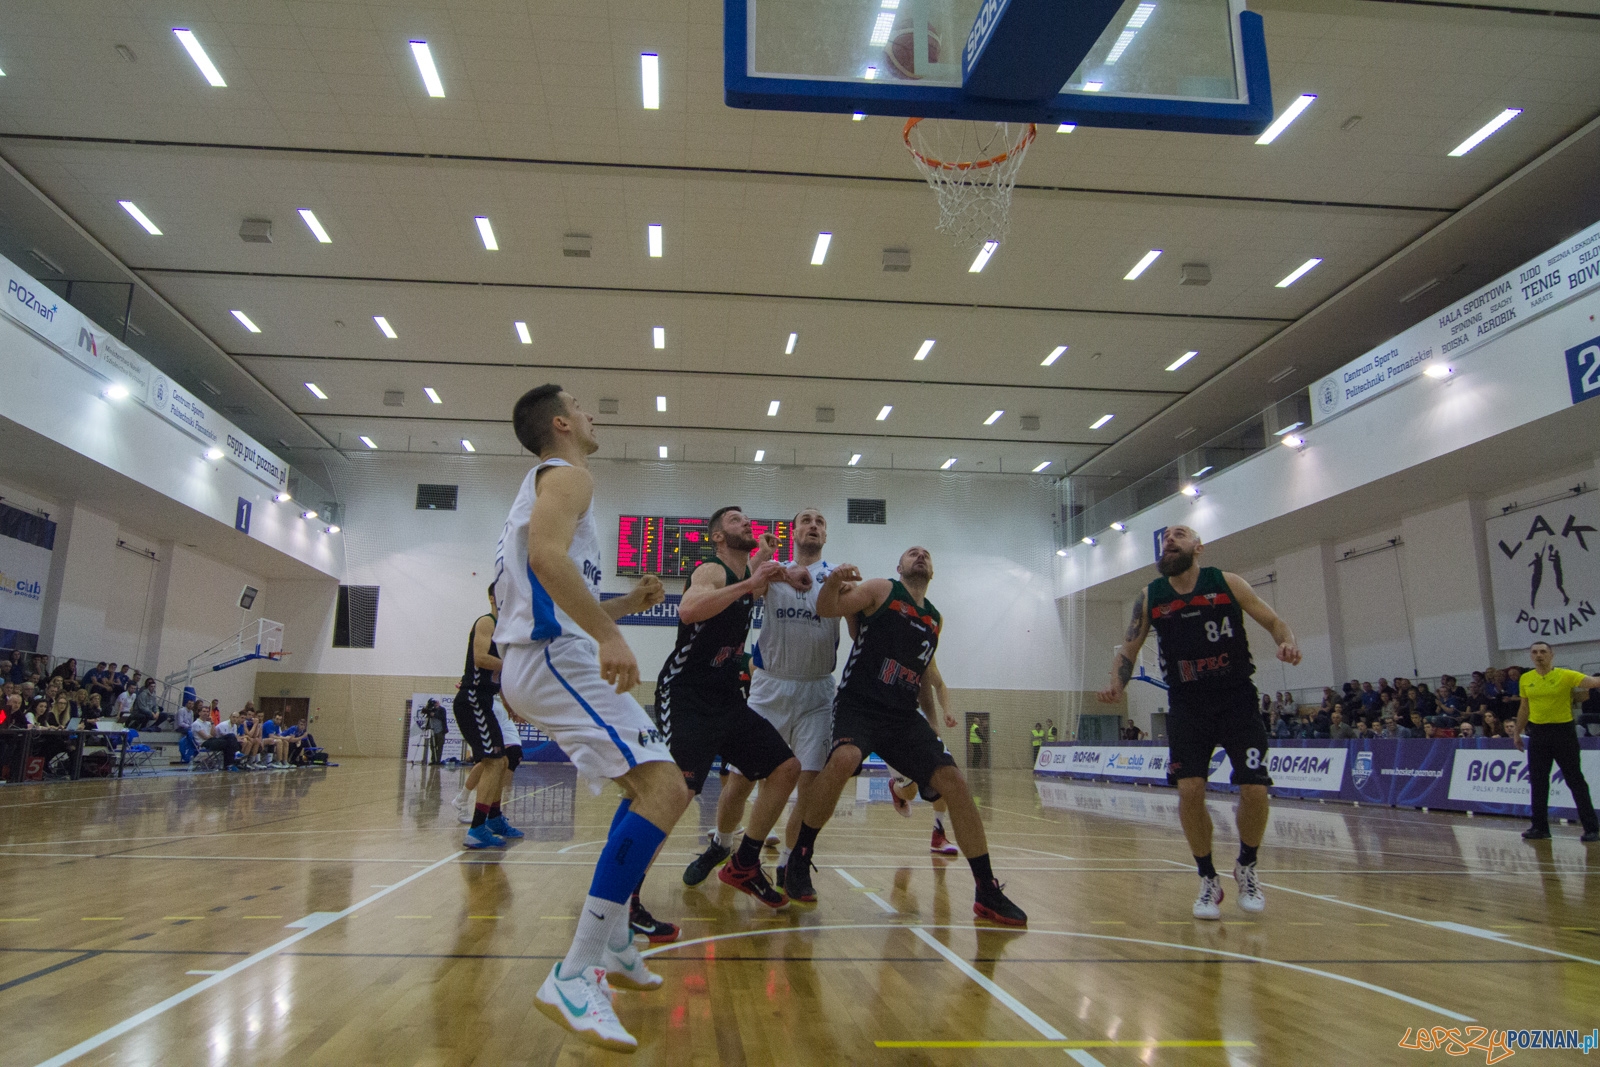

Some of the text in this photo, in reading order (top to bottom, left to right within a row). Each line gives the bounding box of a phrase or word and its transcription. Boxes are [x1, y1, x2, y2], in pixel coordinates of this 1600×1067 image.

[1519, 265, 1541, 284] JUDO
[1521, 269, 1561, 300] TENIS
[1439, 281, 1512, 328] HALA SPORTOWA
[1490, 296, 1513, 313] SZACHY
[1530, 292, 1553, 308] KARATE
[1441, 307, 1517, 355] BOISKA AEROBIK
[1344, 348, 1399, 383] Centrum Sportu
[1345, 347, 1433, 400] Politechniki Poznańskiej
[1577, 345, 1600, 393] 2
[173, 389, 205, 419] Centrum Sportu
[227, 434, 287, 484] cspp.put.poznan.pl
[241, 503, 248, 530] 1
[684, 532, 700, 542] 46
[1204, 616, 1233, 642] 84
[1516, 601, 1596, 636] POZNAŃ
[1196, 653, 1230, 672] PEC
[27, 759, 42, 774] 5
[1072, 751, 1100, 763] BIOFARM
[1118, 754, 1144, 765] funclub
[1269, 755, 1331, 774] BIOFARM
[1472, 785, 1530, 795] POLSKI PRODUCEN
